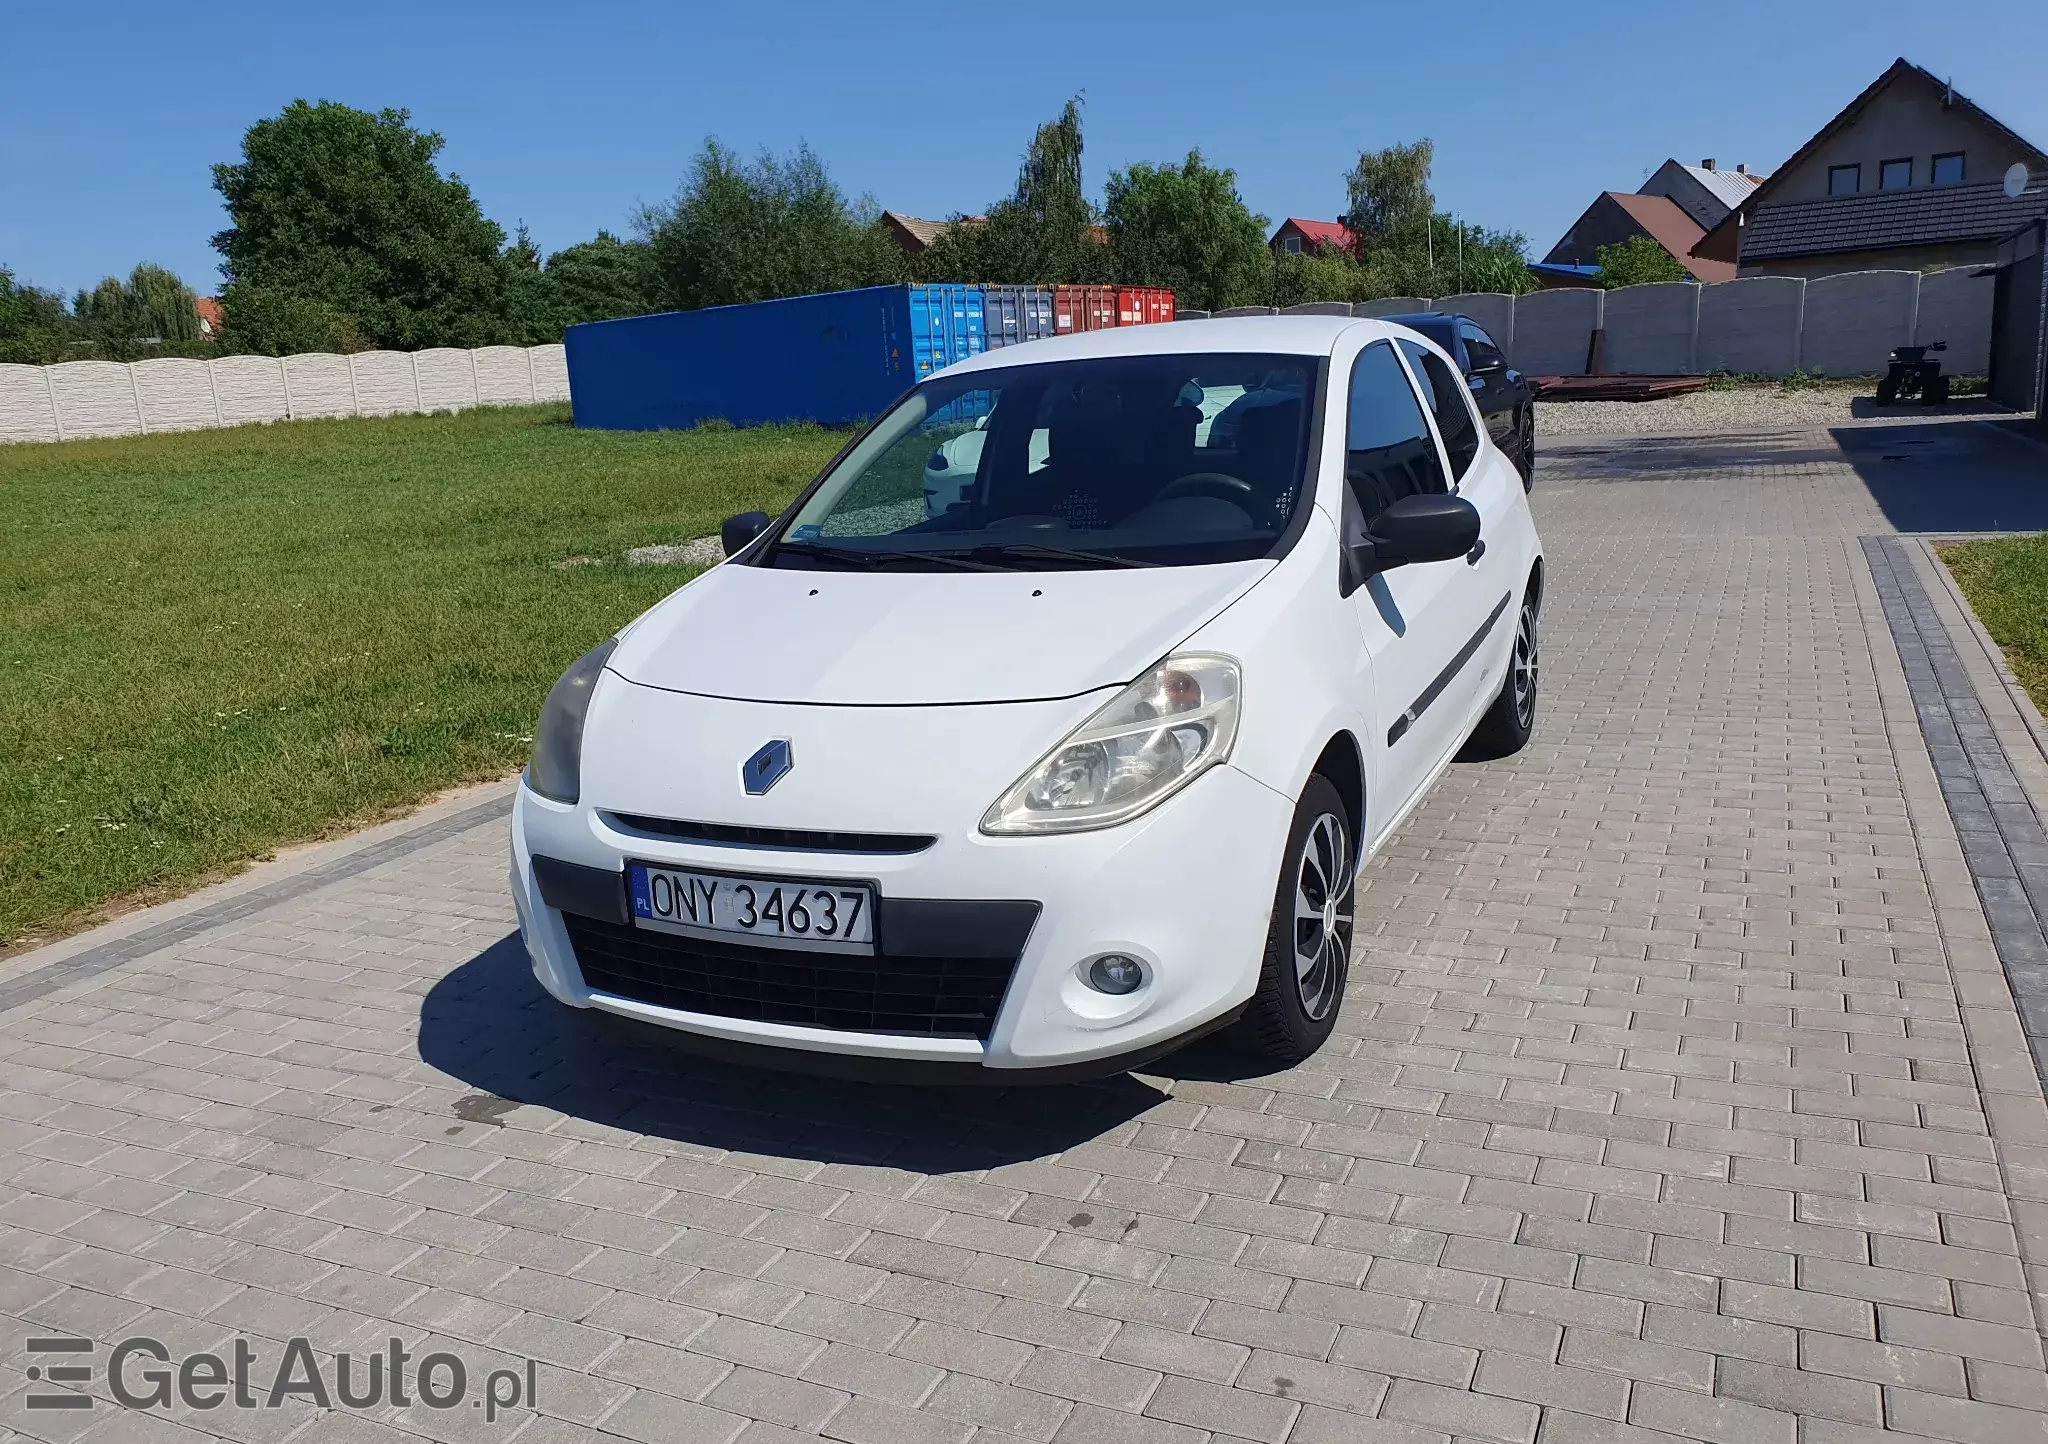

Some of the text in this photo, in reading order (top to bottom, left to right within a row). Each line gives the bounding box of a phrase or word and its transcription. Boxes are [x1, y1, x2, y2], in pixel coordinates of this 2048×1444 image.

[636, 897, 650, 911] PL
[651, 873, 864, 938] ONY 34637
